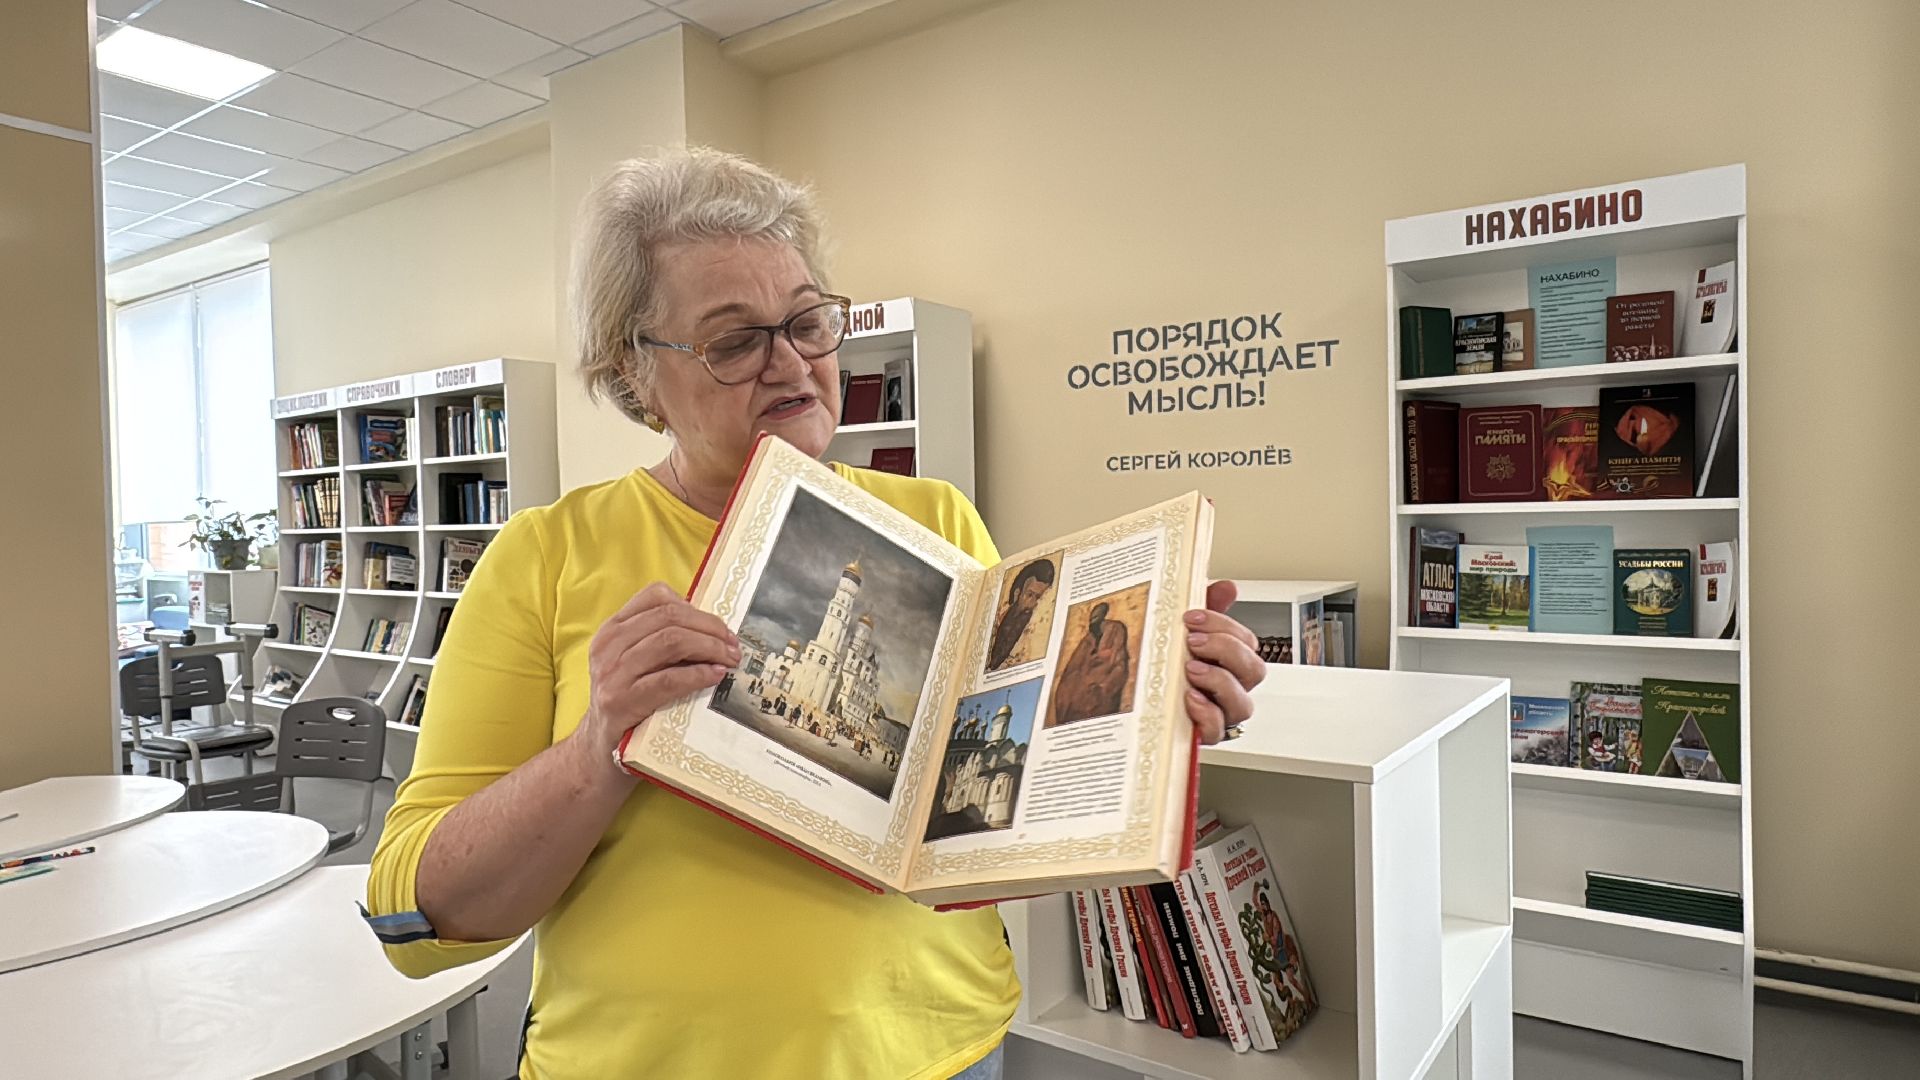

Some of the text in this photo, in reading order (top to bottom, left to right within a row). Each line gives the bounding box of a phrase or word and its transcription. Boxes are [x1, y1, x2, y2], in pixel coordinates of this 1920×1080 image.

[1465, 189, 1643, 246] НАХАБИНО
[1540, 268, 1600, 283] НАХАБИНО
[1113, 312, 1282, 354] ПОРЯДОК
[436, 366, 476, 388] СЛОВАРИ
[1067, 340, 1340, 389] ОСВОБОЖДАЕТ
[346, 379, 401, 404] СПРАВОЧНИКИ
[1128, 381, 1266, 415] МЫСЛЬ!
[1475, 434, 1526, 445] ПАМЯТИ
[1106, 445, 1292, 471] СЕРГЕЙ КОРОЛЁВ
[1423, 562, 1454, 589] АТЛАС
[1653, 560, 1683, 568] РОССИИ
[1205, 892, 1224, 924] Легенды
[1185, 908, 1205, 951] ДРЕВНЕЙ
[1163, 902, 1204, 1016] ПОСЛЕДНИЕ ДНИ ПОМПЕИ
[1202, 954, 1218, 988] МИФЫ
[1217, 998, 1238, 1043] ЛЕГЕНДЫ
